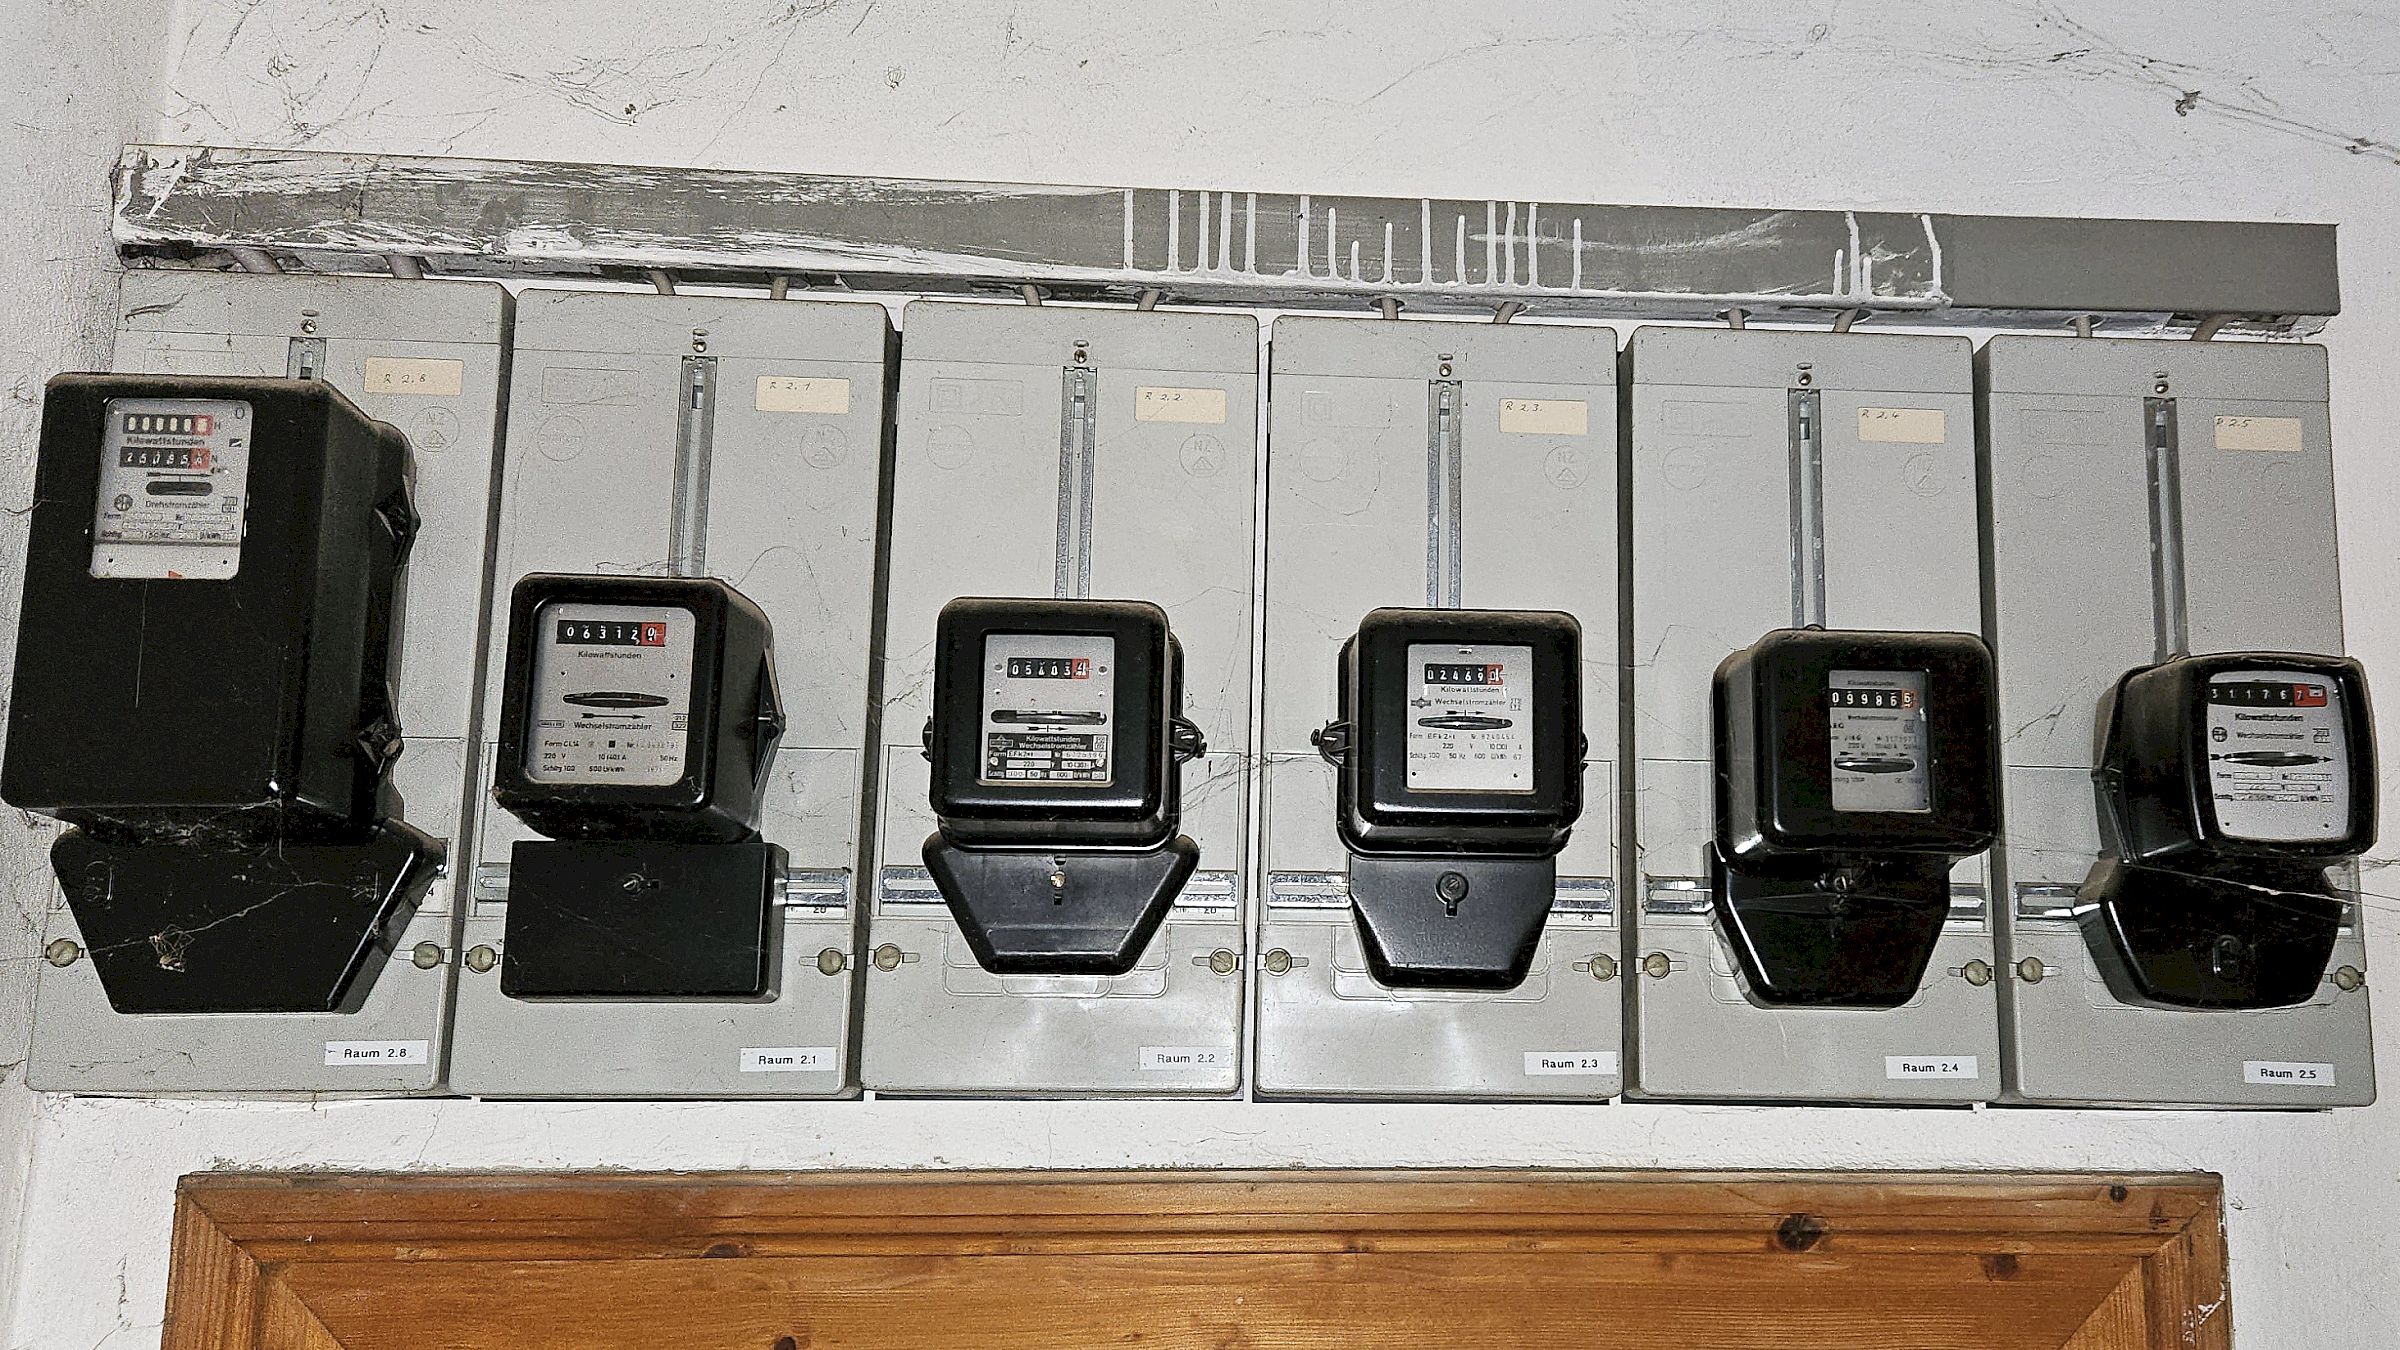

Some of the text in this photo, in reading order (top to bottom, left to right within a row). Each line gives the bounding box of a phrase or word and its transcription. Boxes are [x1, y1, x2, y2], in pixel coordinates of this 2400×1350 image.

[577, 650, 642, 660] Kilowattstunden
[343, 1048, 407, 1059] Raum 2.8
[1156, 1053, 1215, 1064] Raum 2.2
[758, 1055, 817, 1065] Raum 2.1
[1541, 1059, 1598, 1069] Raum 2.3
[1902, 1063, 1959, 1073] Raum 2.4
[2260, 1068, 2317, 1079] Raum 2.5
